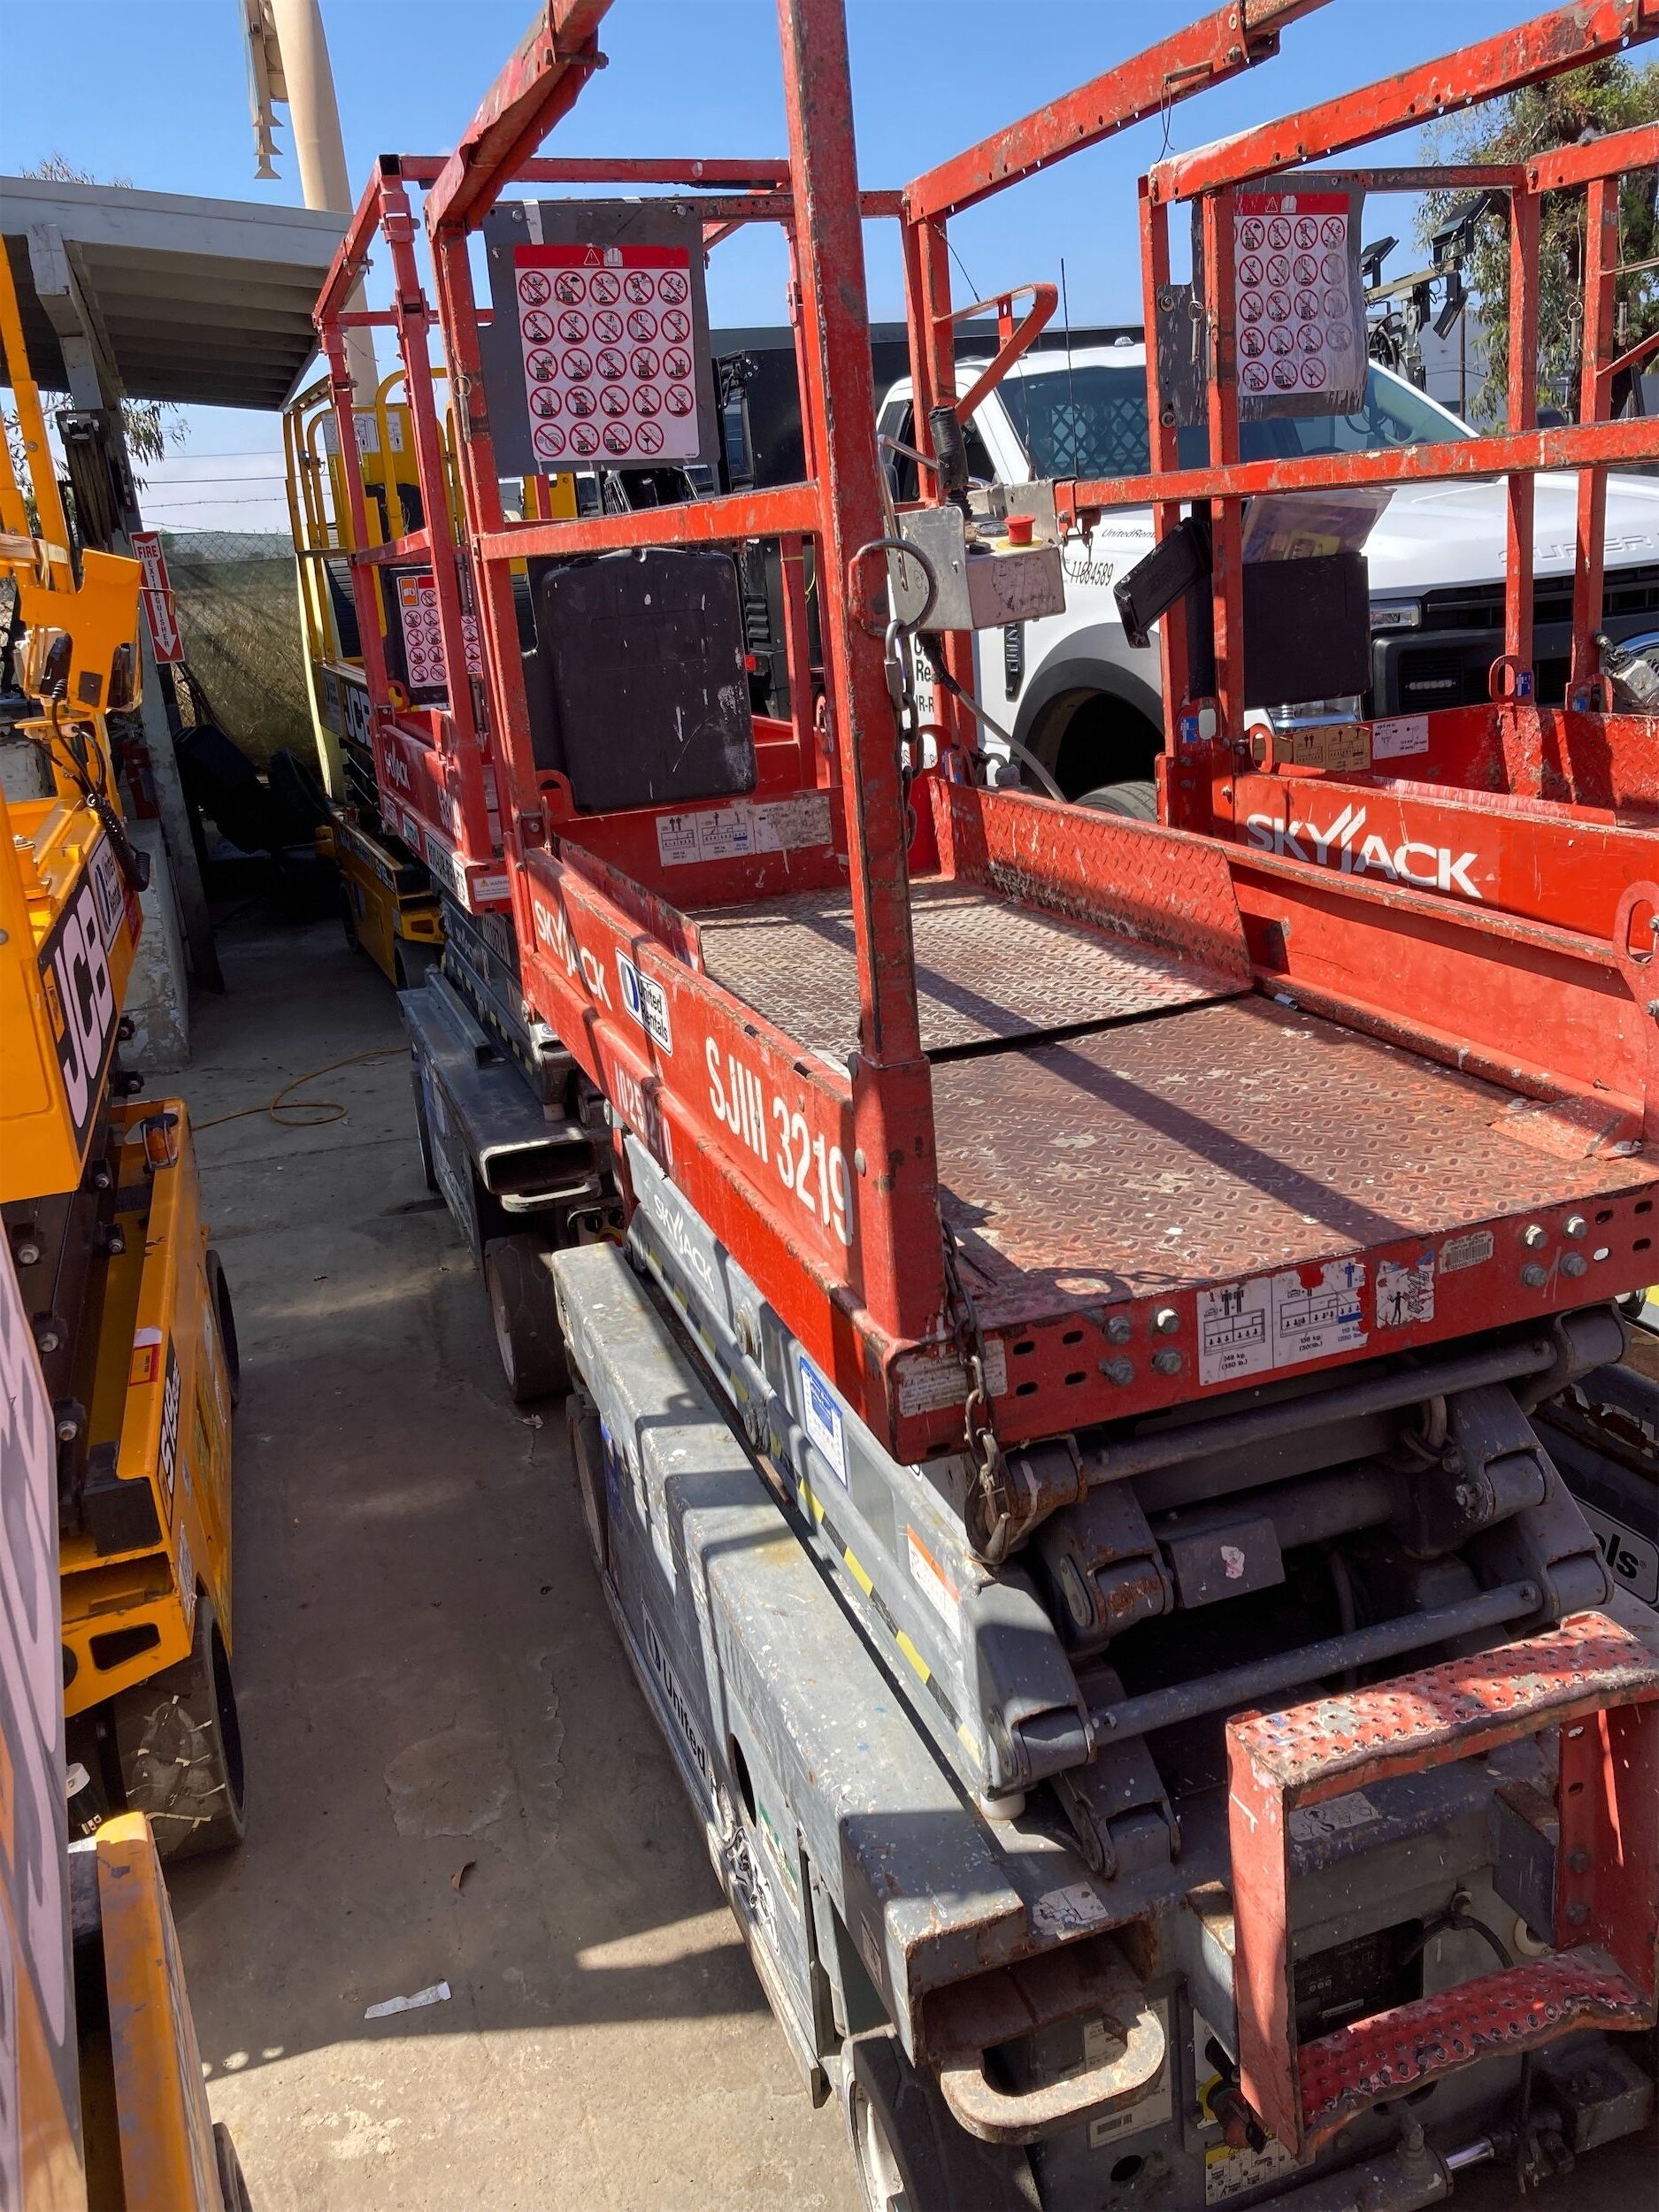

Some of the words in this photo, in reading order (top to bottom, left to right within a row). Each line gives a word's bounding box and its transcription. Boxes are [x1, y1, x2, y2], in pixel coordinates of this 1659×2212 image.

[137, 545, 158, 559] FIRE
[148, 559, 170, 648] EXTINGUISHER
[1246, 803, 1483, 899] SKYJACK
[534, 899, 612, 1011] SKYJACK
[638, 977, 664, 1013] United
[54, 885, 114, 1128] JCB
[641, 1001, 669, 1043] Rentals
[772, 1096, 853, 1247] 3219
[653, 1194, 715, 1293] SKYJACK
[661, 1666, 708, 1778] United
